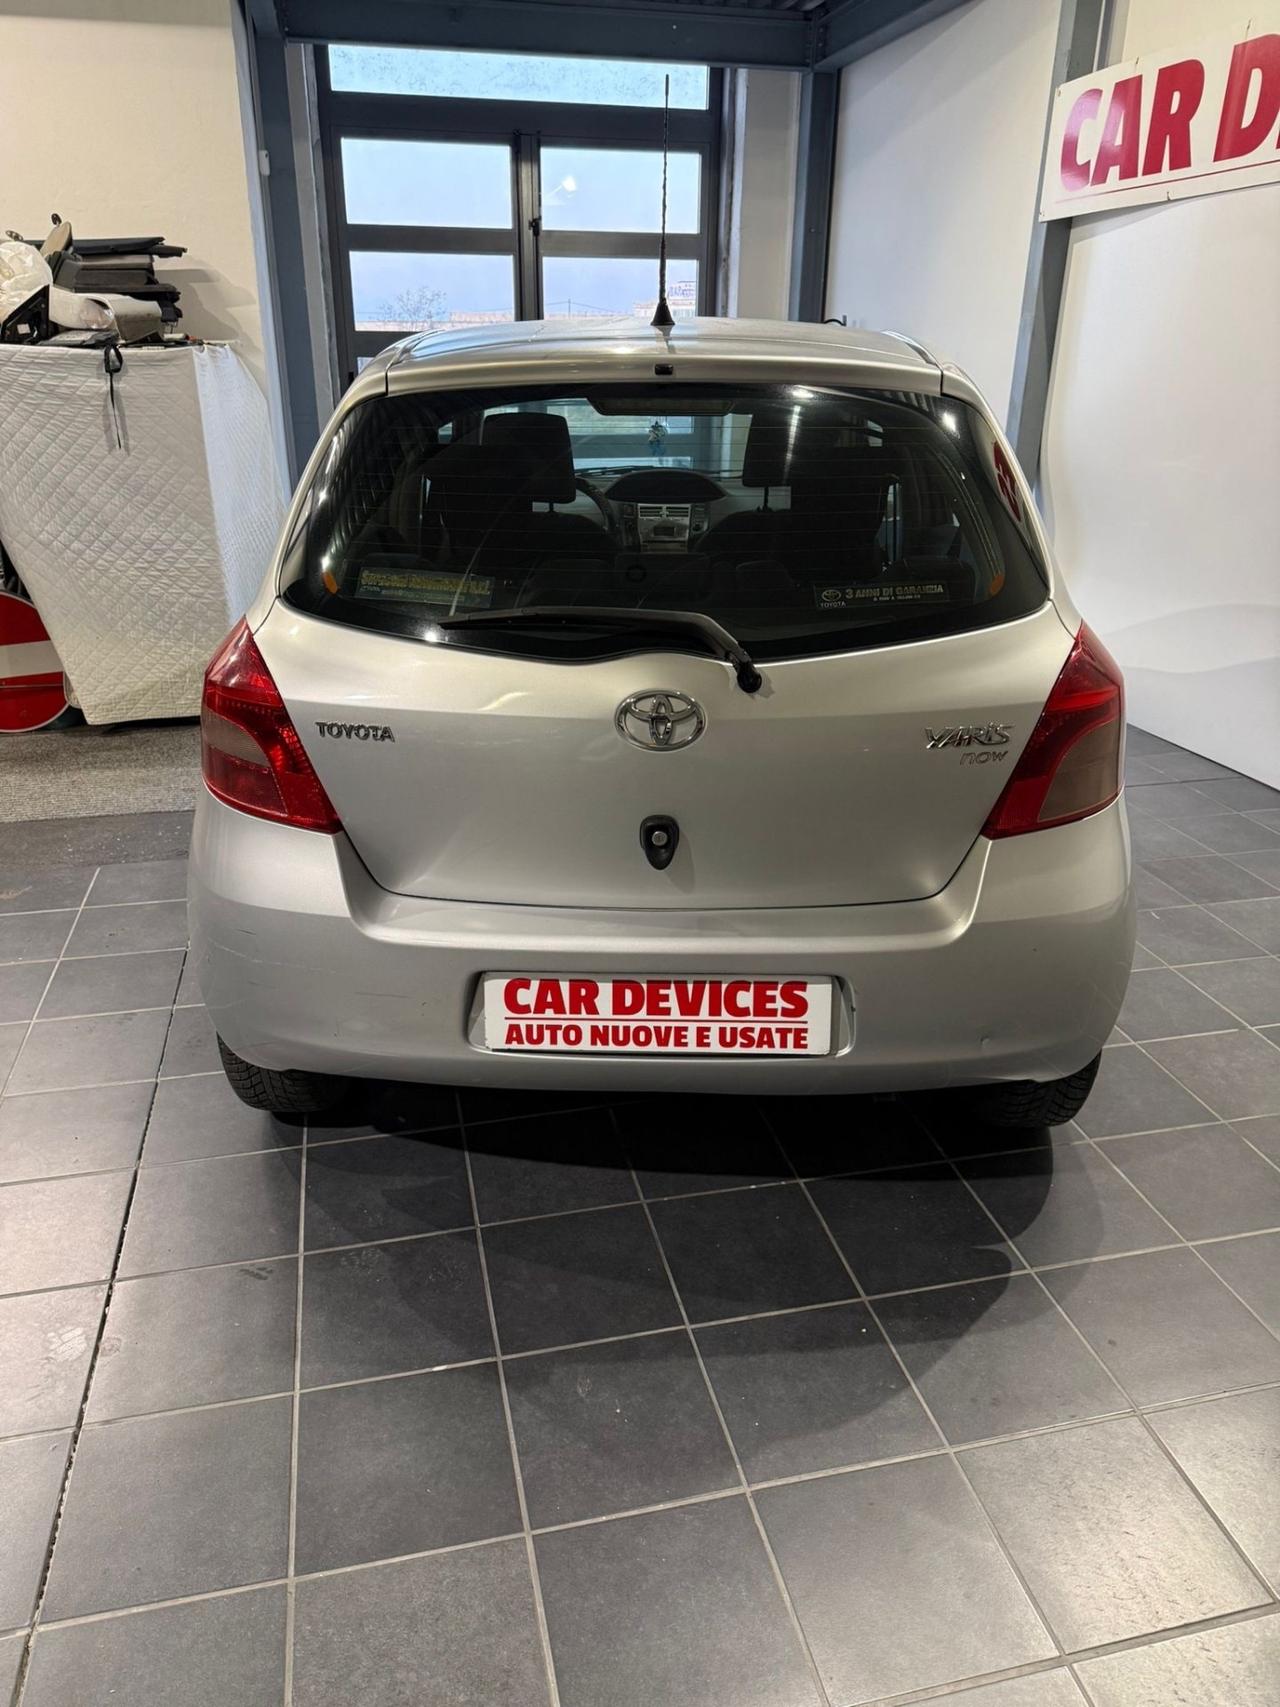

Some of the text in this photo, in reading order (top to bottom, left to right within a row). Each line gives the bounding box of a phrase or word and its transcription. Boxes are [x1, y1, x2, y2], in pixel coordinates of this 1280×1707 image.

[1061, 34, 1280, 192] CAR D
[845, 588, 854, 599] 3
[855, 588, 880, 598] ANNI
[883, 587, 893, 596] DI
[820, 601, 847, 609] TOYOTA
[315, 722, 395, 743] TOYOTA
[504, 977, 809, 1018] CAR DEVICES
[505, 1023, 809, 1049] AUTO NUOVE E USATE
